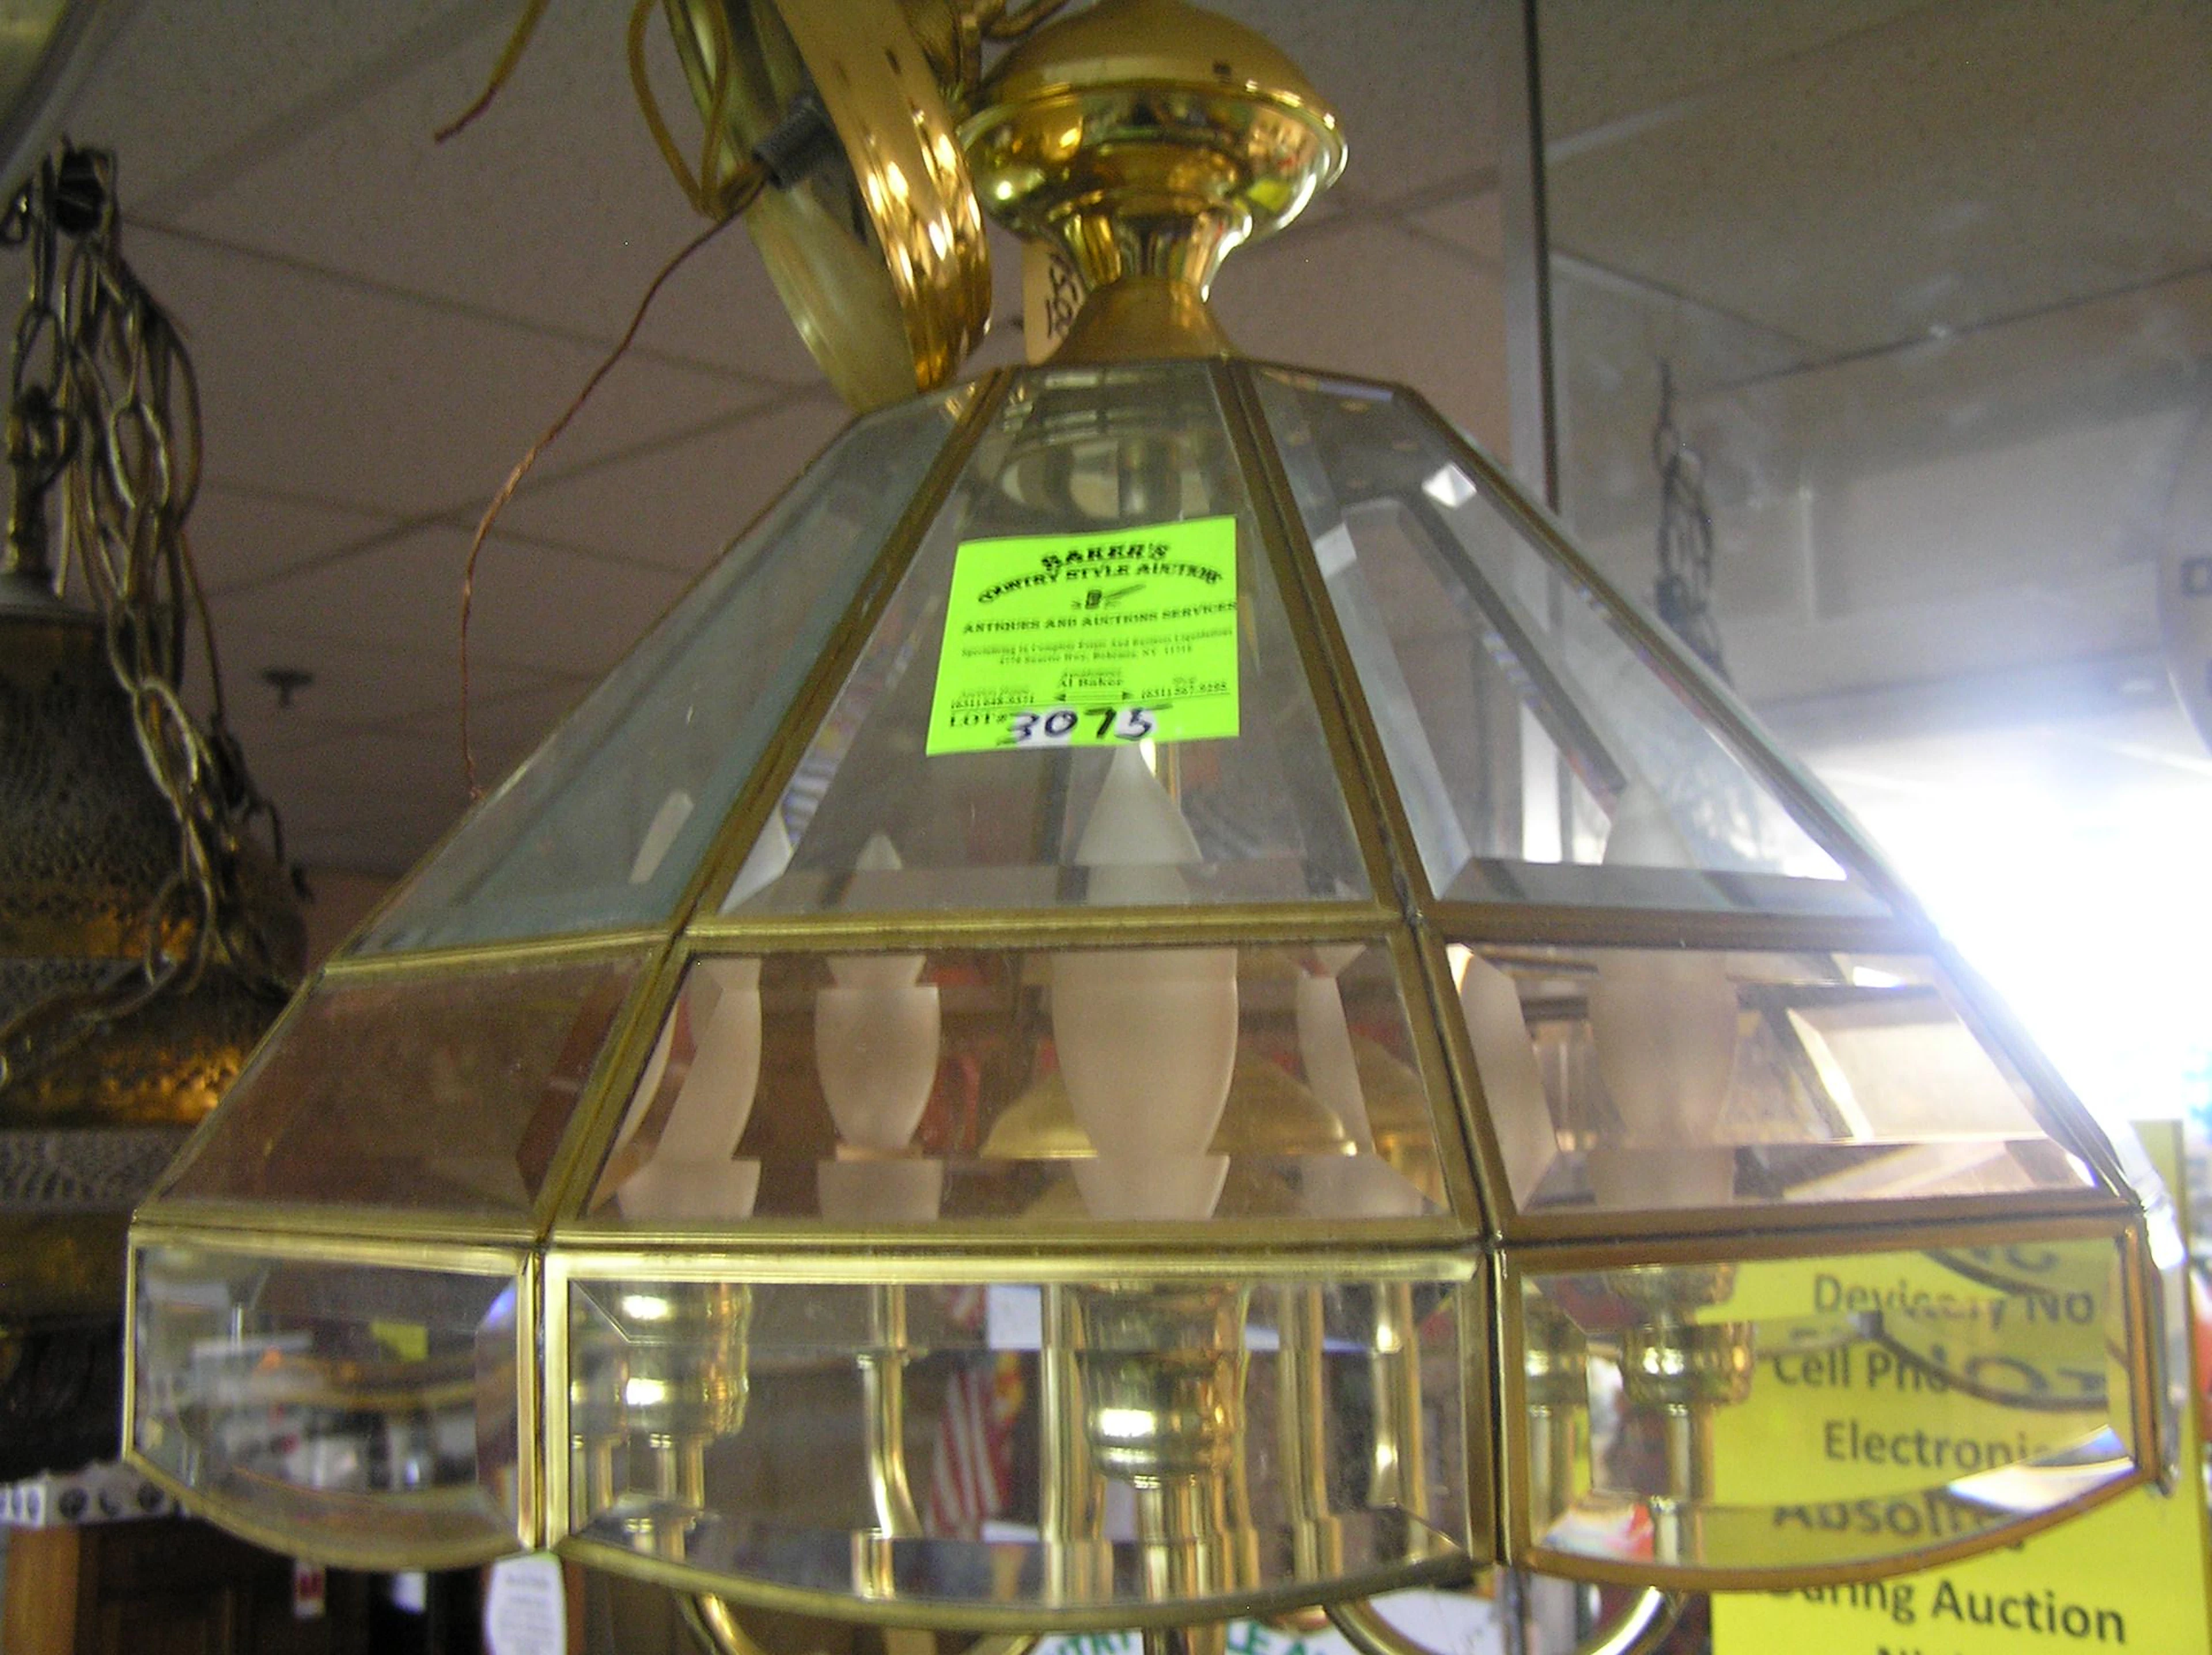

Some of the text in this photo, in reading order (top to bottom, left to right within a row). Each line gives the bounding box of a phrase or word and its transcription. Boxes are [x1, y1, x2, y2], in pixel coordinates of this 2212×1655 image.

[1041, 541, 1171, 571] BAKER'S
[1066, 563, 1129, 580] STYLE
[963, 601, 1237, 634] ANTIQUES AND AUCTIONS SERVICES
[1078, 676, 1124, 688] Baker
[1002, 705, 1172, 743] 3075
[1772, 1345, 1850, 1388] Cell
[1824, 1419, 2051, 1472] Electroni
[1766, 1580, 2127, 1646] uring Auction
